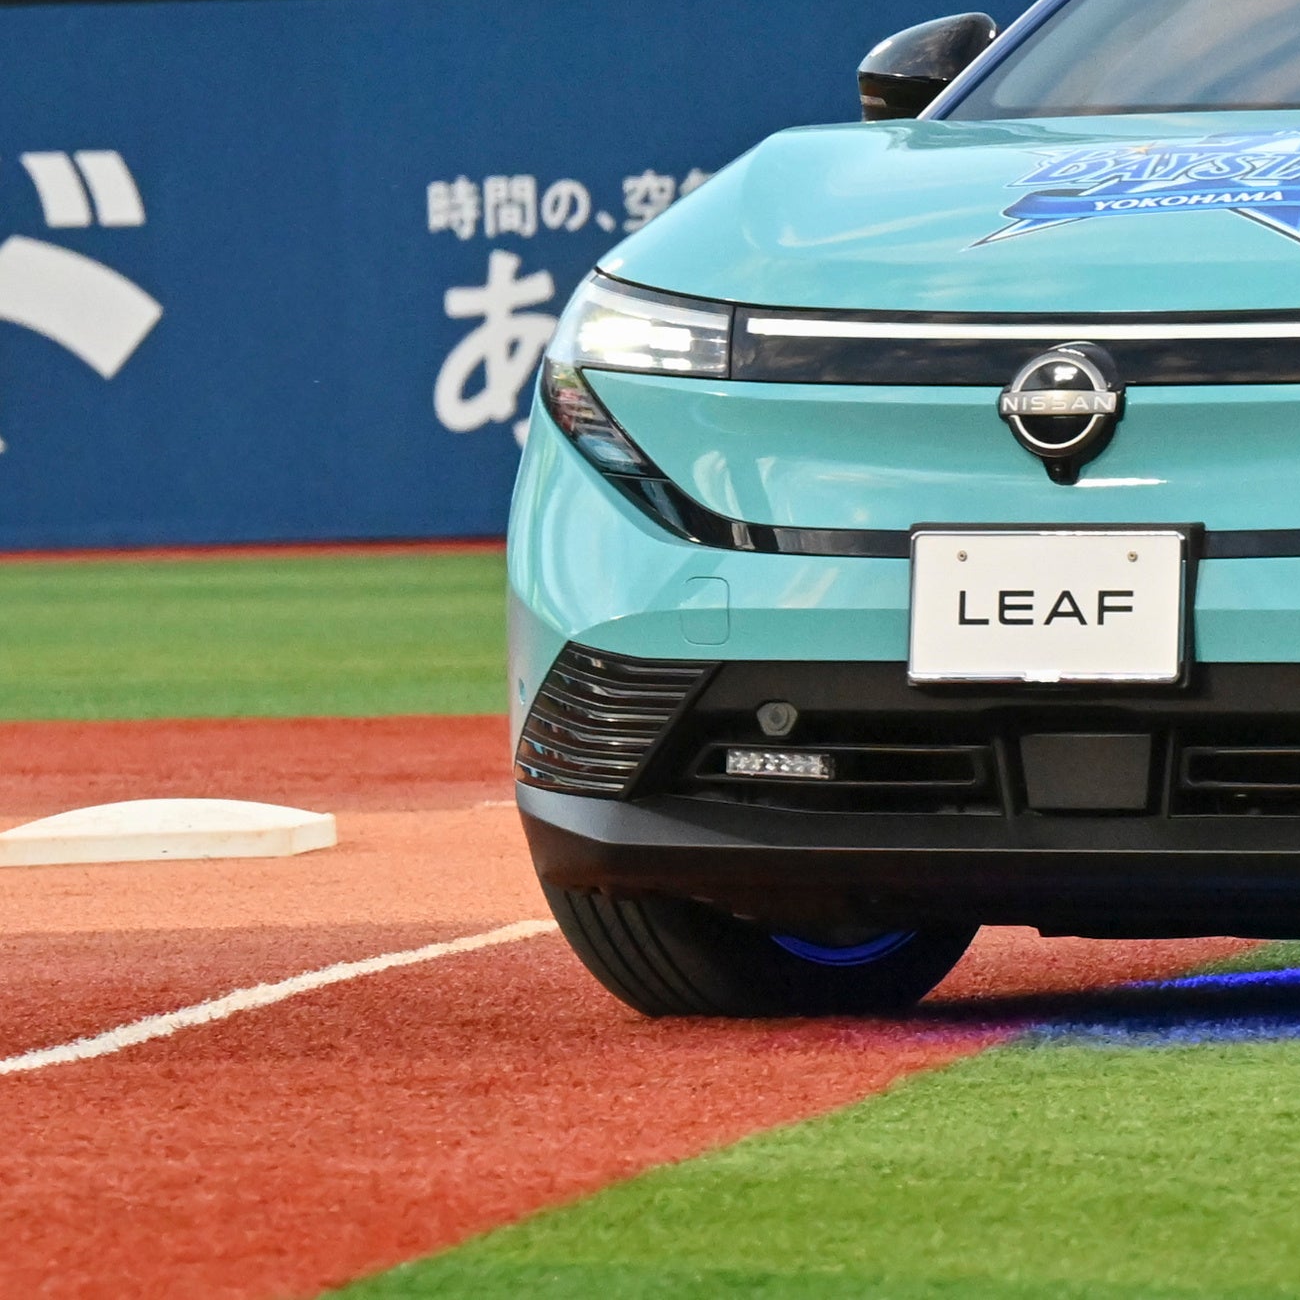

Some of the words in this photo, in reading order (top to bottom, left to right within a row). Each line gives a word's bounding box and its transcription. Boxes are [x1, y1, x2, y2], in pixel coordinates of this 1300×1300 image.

[1093, 189, 1284, 213] YOKOHAMA
[1002, 394, 1115, 413] NISSAN
[957, 589, 1135, 626] LEAF
